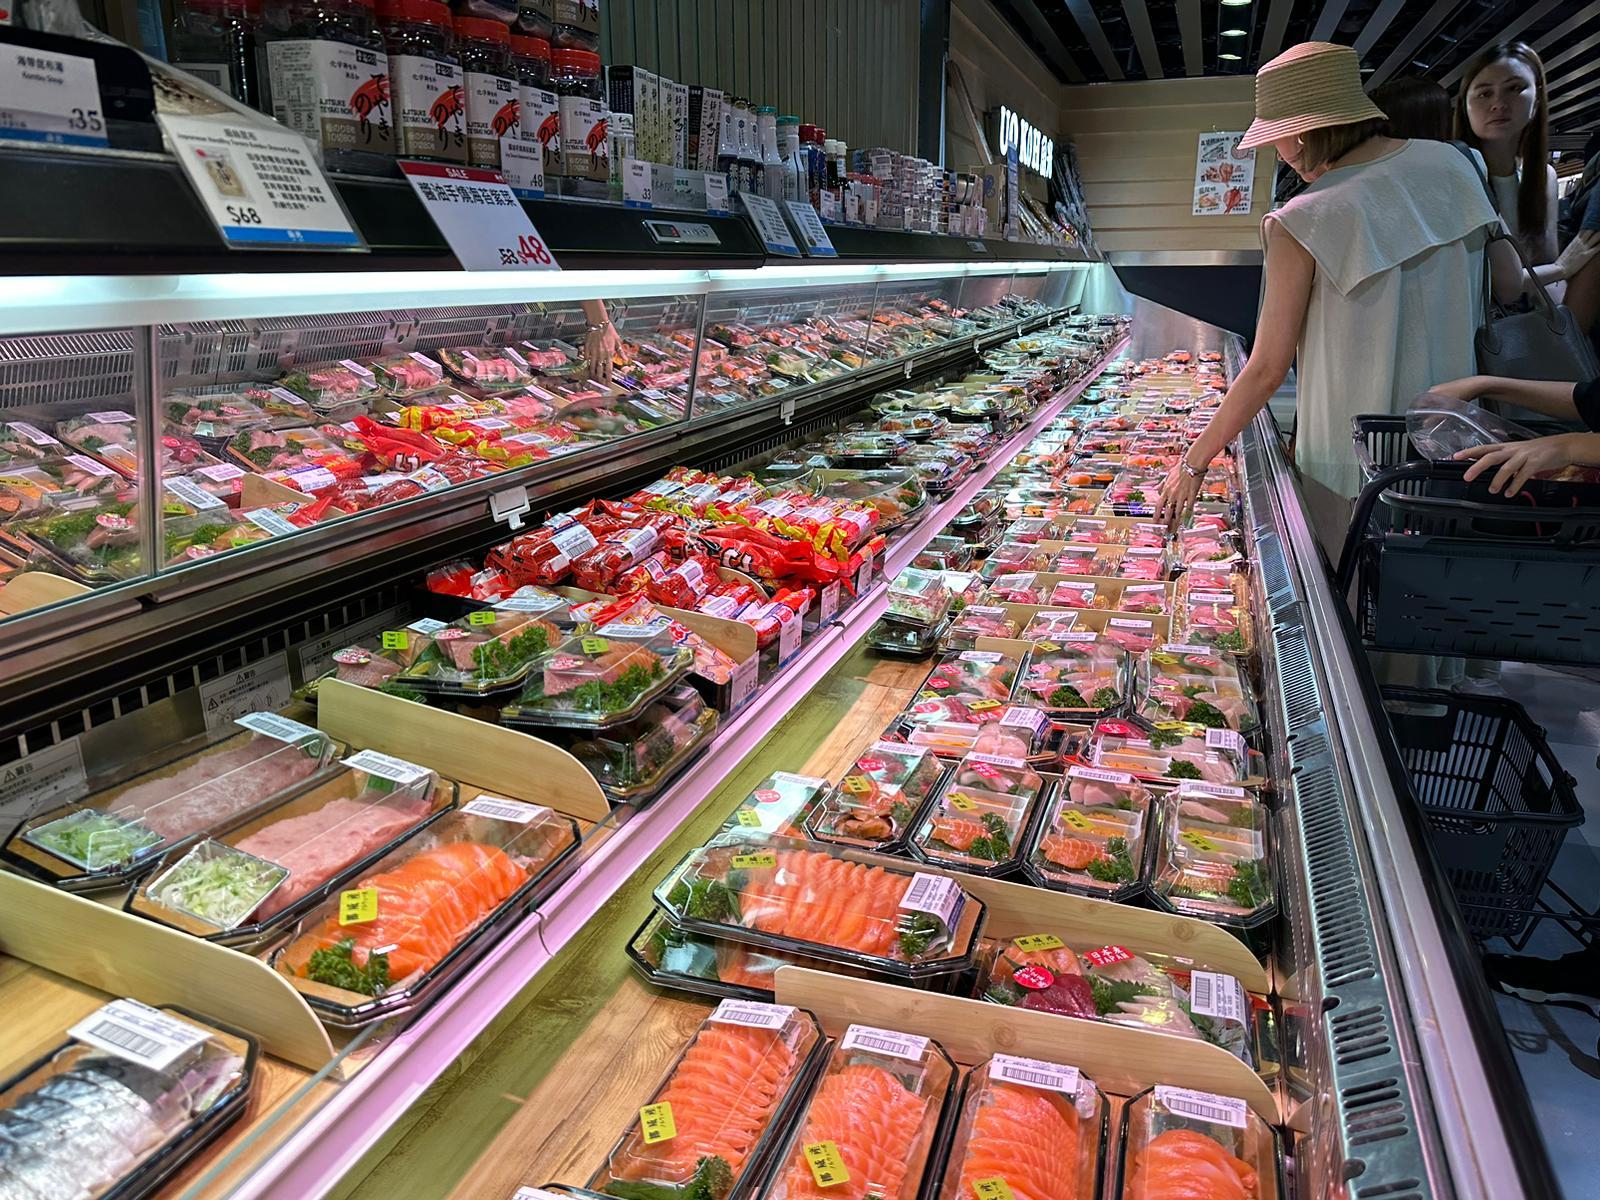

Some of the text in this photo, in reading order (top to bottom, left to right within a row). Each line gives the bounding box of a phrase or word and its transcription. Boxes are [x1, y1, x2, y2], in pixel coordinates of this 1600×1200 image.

[445, 167, 469, 180] SALE
[226, 204, 262, 225] $68
[515, 234, 552, 266] $48
[1096, 951, 1131, 966] JAPAN
